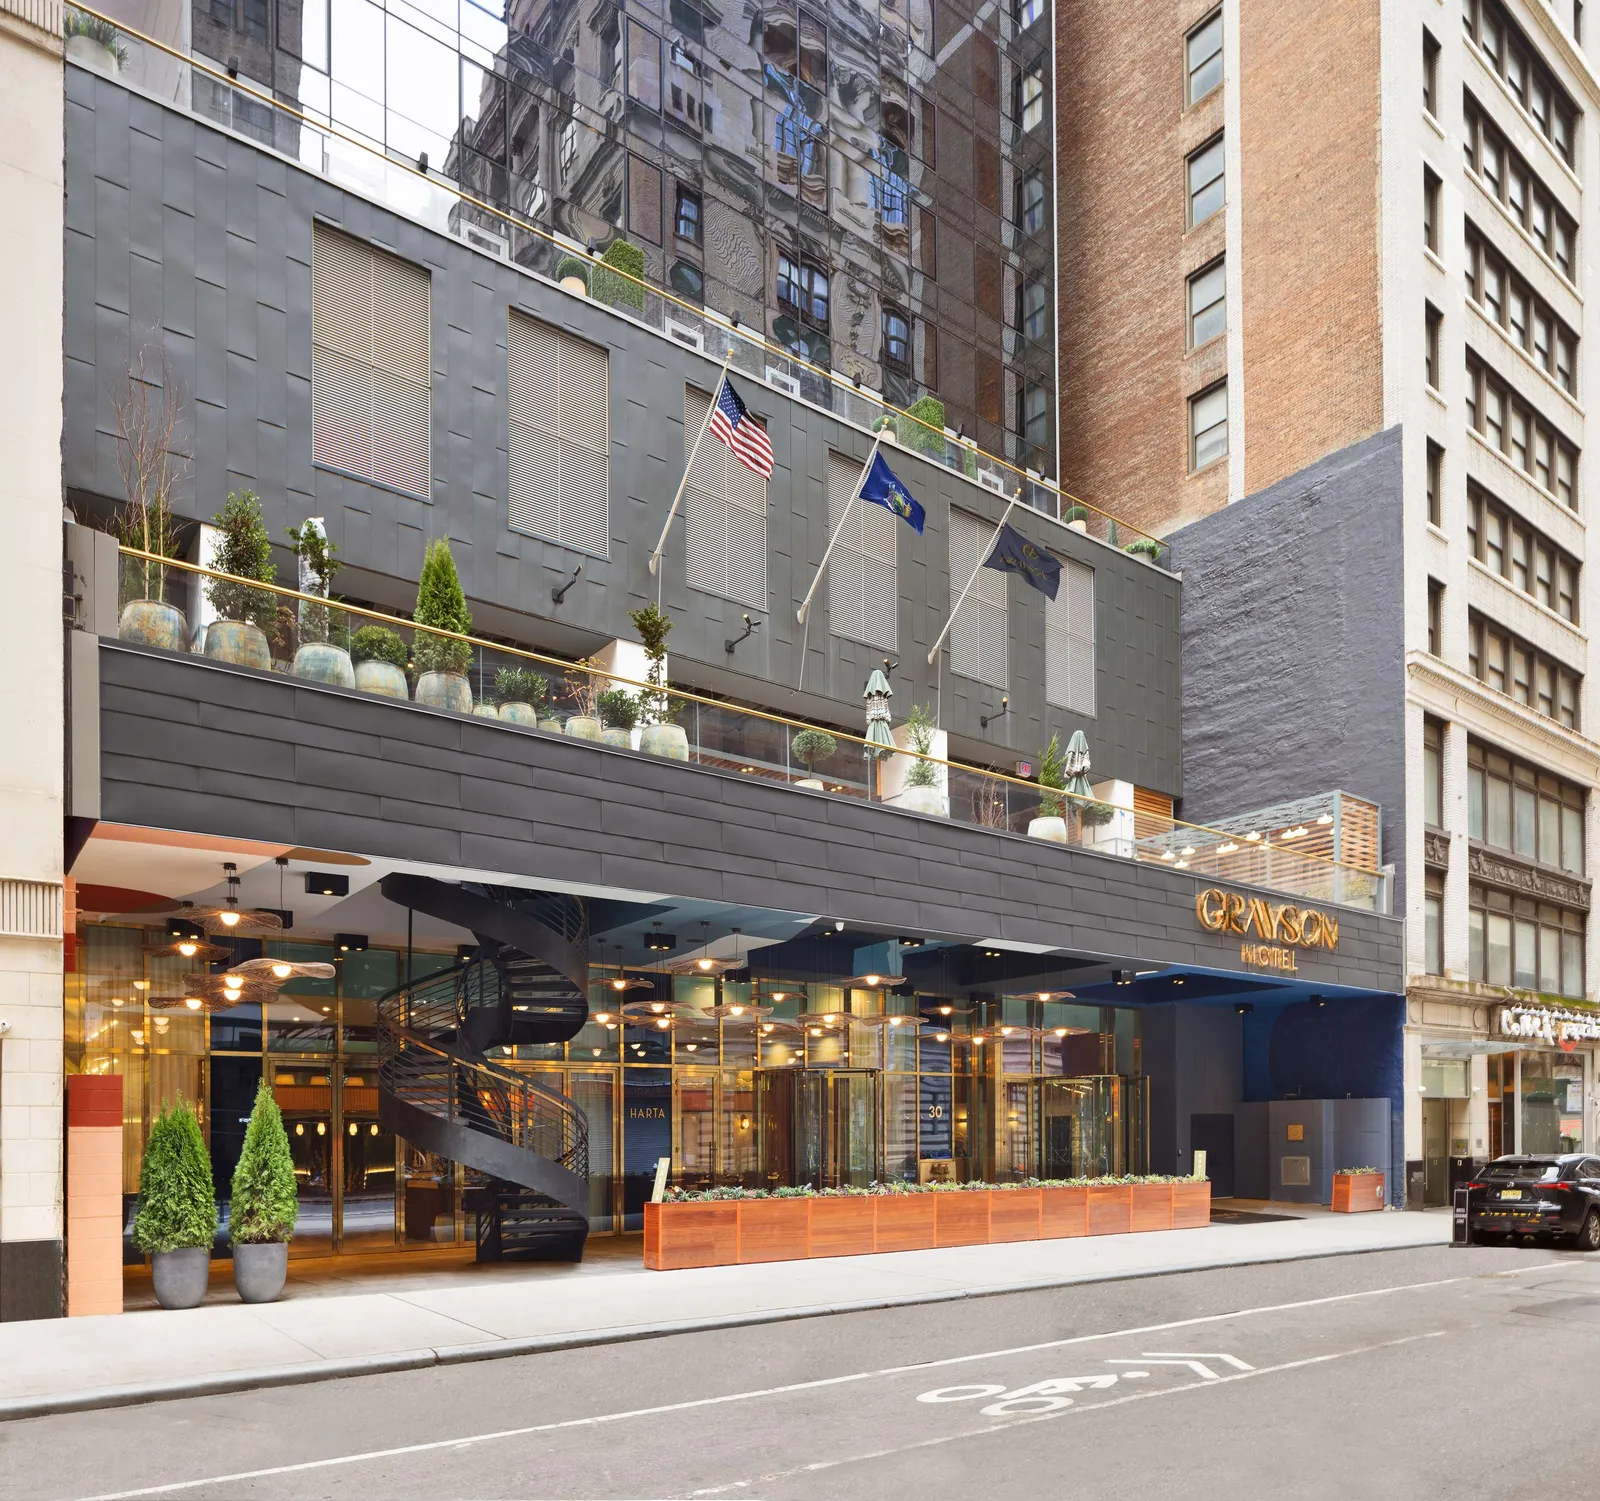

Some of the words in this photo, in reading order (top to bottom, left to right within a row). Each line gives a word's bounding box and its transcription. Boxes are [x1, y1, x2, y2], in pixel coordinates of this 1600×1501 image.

[1195, 888, 1339, 950] GRAYSON
[1241, 943, 1299, 971] HOTEL
[630, 1107, 665, 1119] HARTA
[928, 1105, 943, 1118] 30
